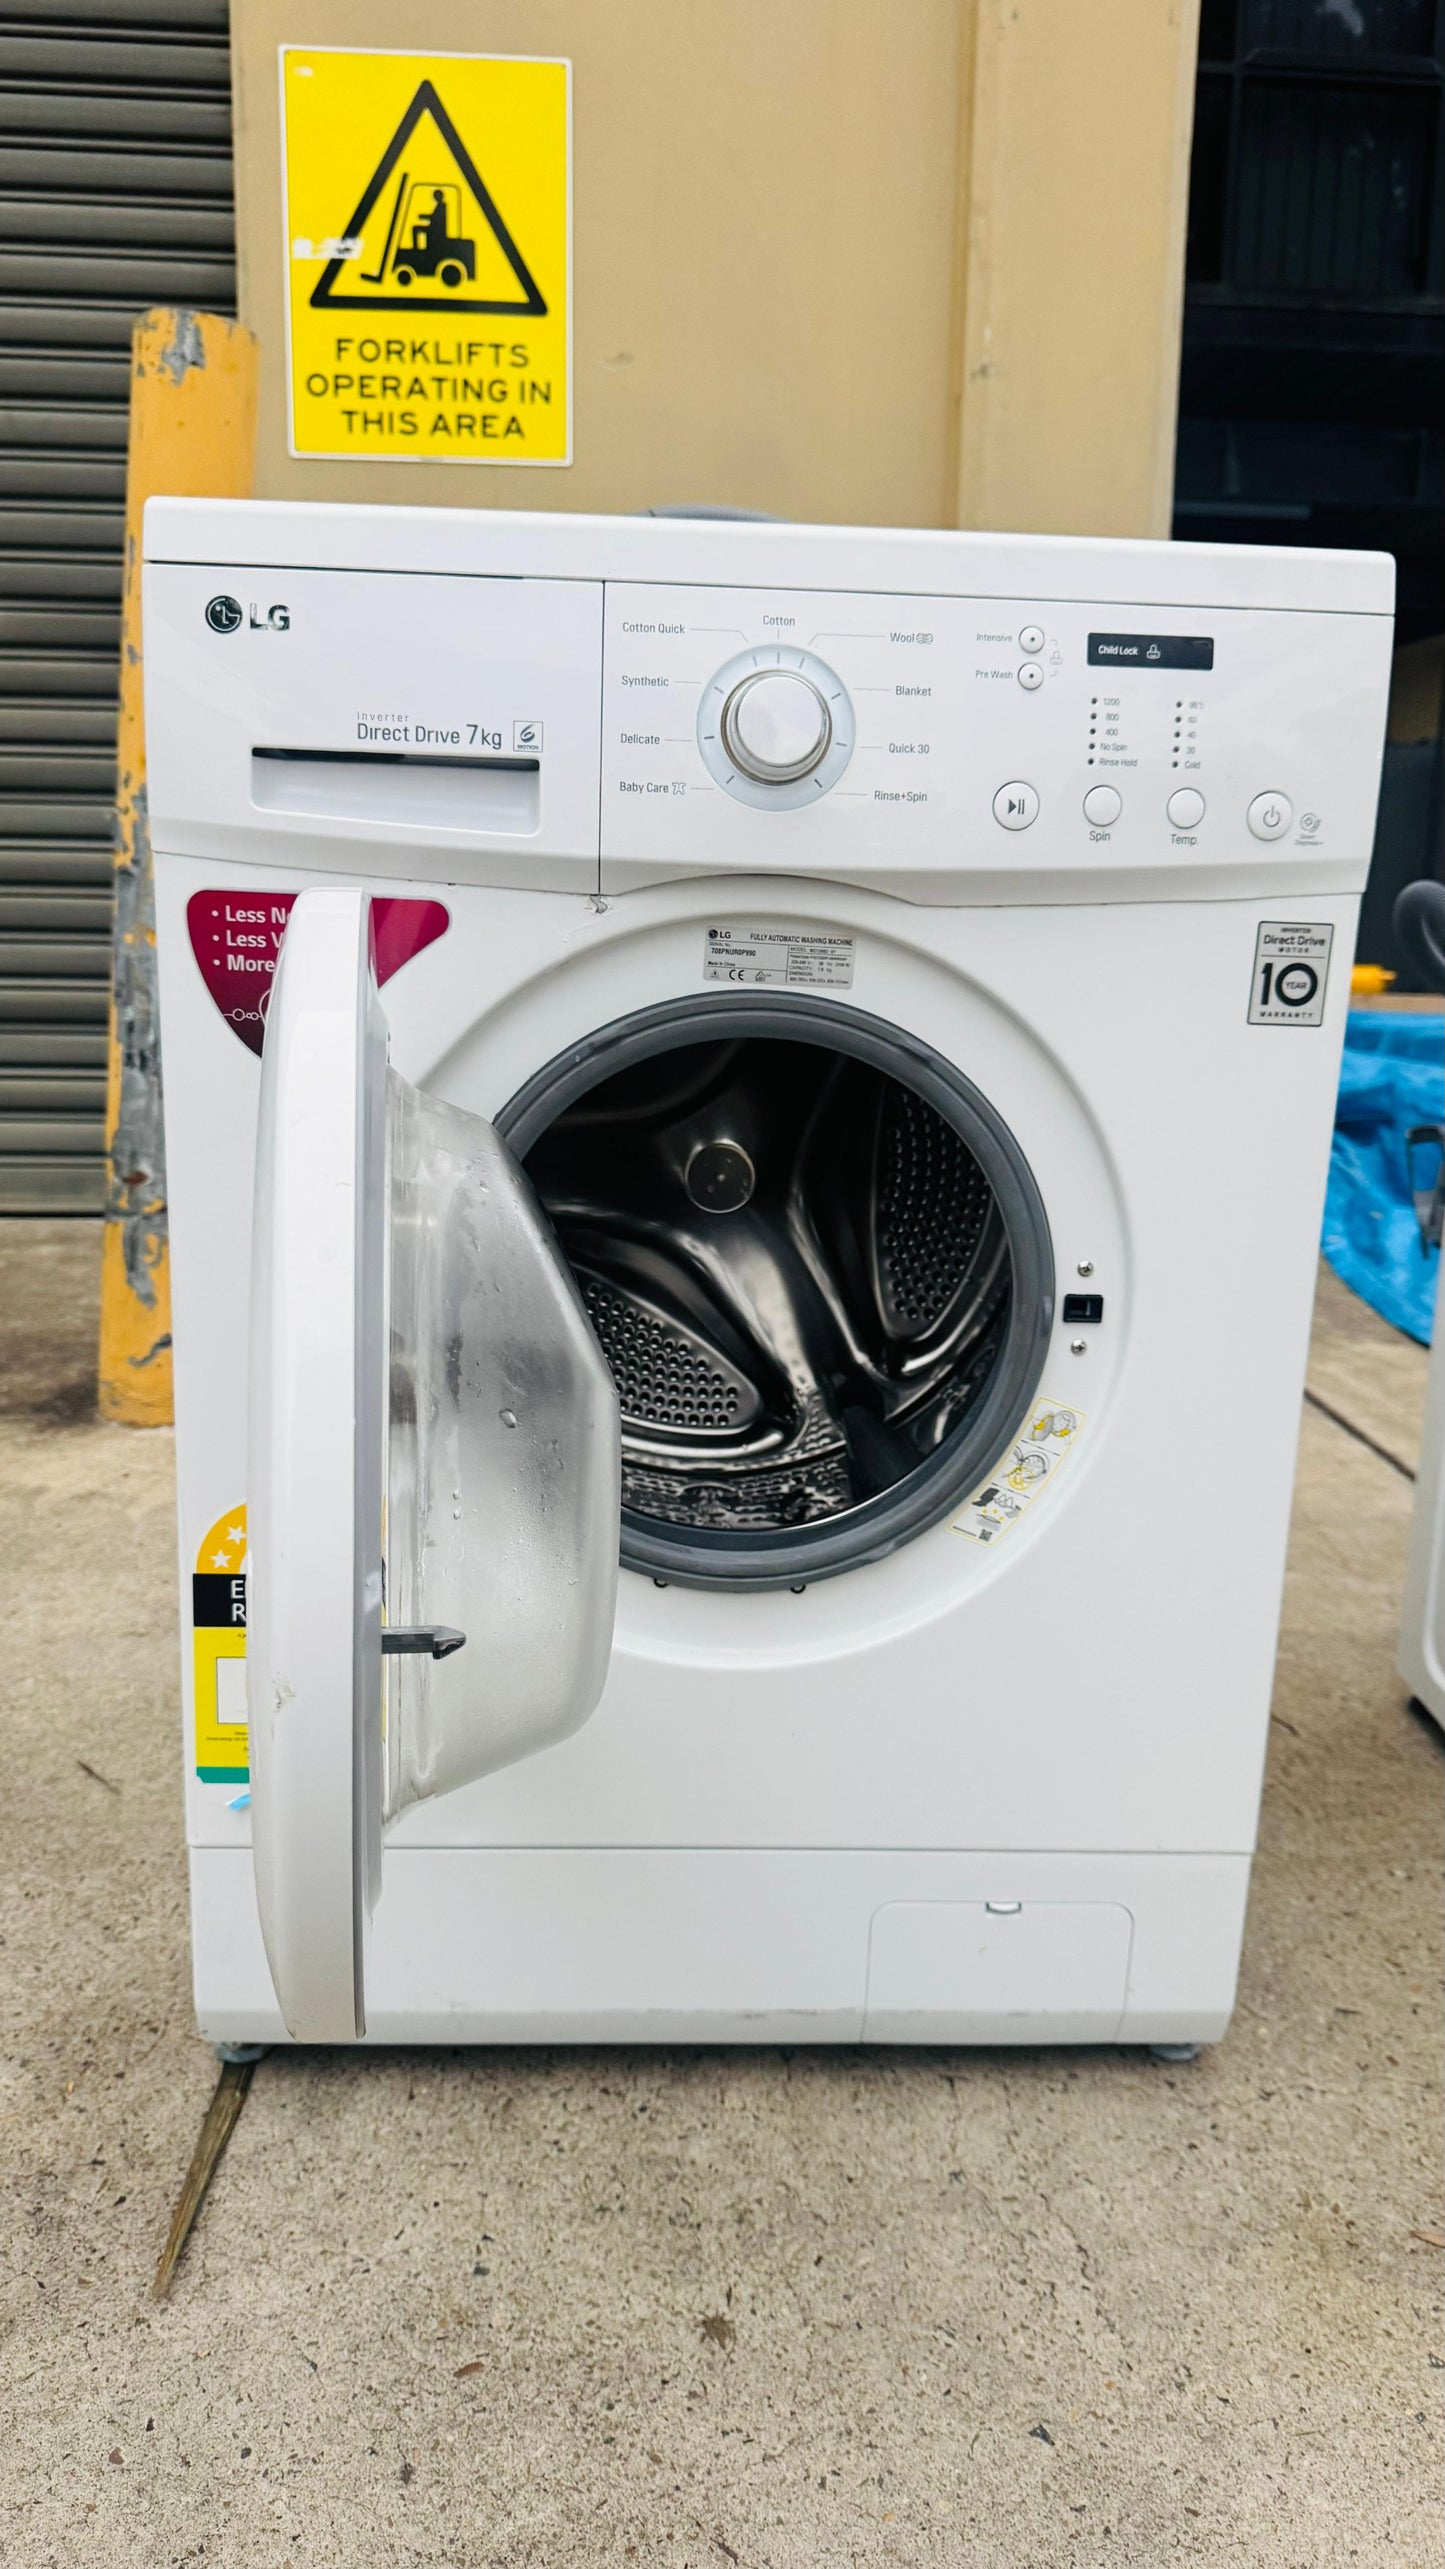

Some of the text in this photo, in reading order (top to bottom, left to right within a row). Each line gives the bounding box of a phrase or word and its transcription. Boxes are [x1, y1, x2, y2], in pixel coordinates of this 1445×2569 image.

[335, 338, 530, 367] FORKLIFTS
[306, 373, 552, 404] OPERATING IN
[341, 410, 525, 439] THIS AREA
[250, 603, 291, 630] LG
[763, 615, 795, 627] Cotton
[622, 622, 686, 634] Cotton Quick
[890, 632, 915, 643] Wool
[976, 633, 1013, 643] Intensive
[1098, 645, 1139, 656] Child Lock
[621, 675, 670, 687] Synthetic
[975, 670, 1014, 680] Pre Wash
[895, 685, 932, 697] Blanket
[1103, 698, 1120, 706] 1200
[357, 711, 410, 722] Inverter
[357, 723, 410, 743] Direct
[415, 725, 461, 745] Drive
[620, 733, 661, 745] Delicate
[889, 743, 930, 754] Quick 30
[1100, 743, 1127, 752] No Spin
[619, 782, 669, 794] Baby Care
[874, 790, 928, 803] Rinse+Spin
[1089, 830, 1111, 843] Spin
[1171, 834, 1198, 847] Temp.
[225, 905, 266, 923] Less
[226, 930, 267, 948] Less
[720, 931, 731, 939] LG
[750, 933, 767, 941] FULLY
[768, 934, 800, 943] AUTOMATIC
[1264, 934, 1325, 946] Direct Drive
[227, 954, 275, 972] More
[1261, 963, 1318, 1007] 10
